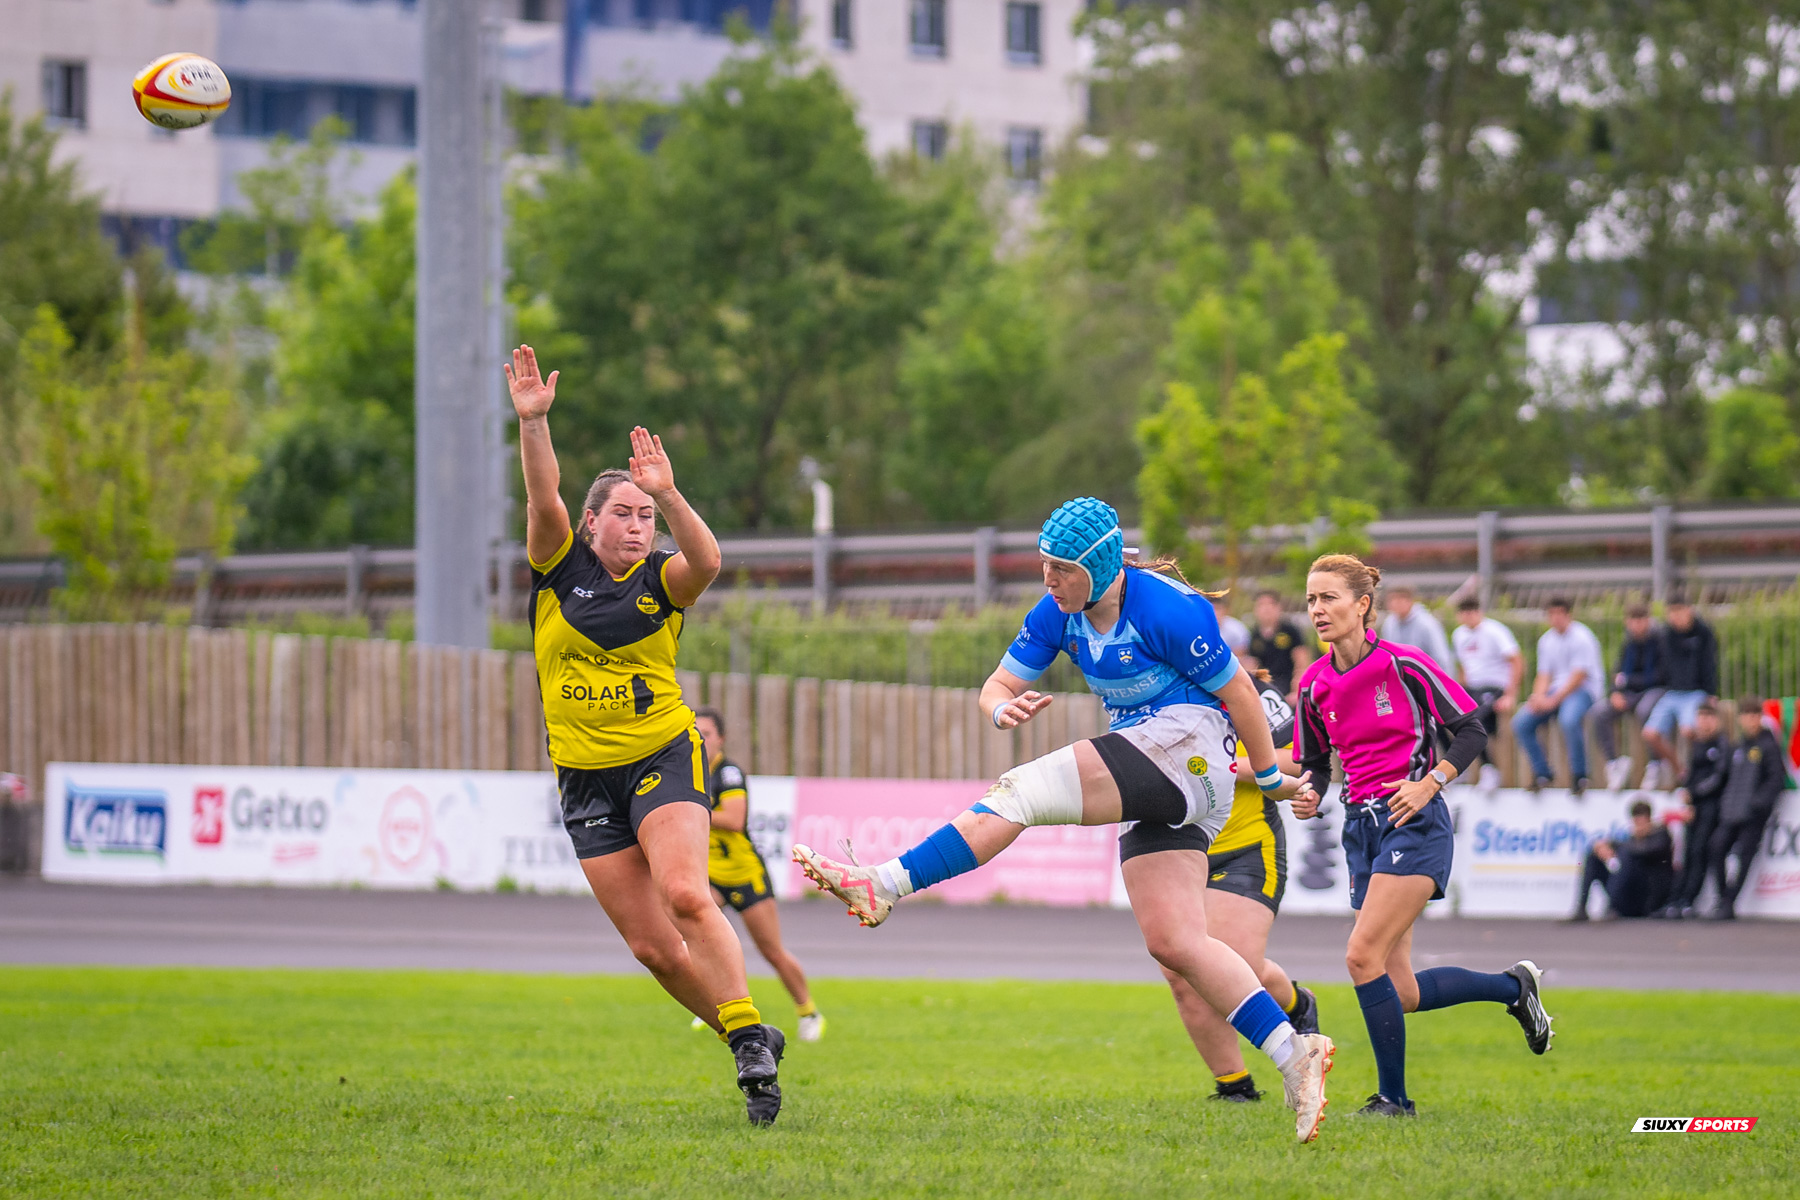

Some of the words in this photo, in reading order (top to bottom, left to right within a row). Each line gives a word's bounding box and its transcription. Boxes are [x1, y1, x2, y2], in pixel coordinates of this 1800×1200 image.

[561, 684, 629, 701] SOLAR
[588, 700, 630, 711] PACK
[1202, 776, 1216, 810] AGUILAR
